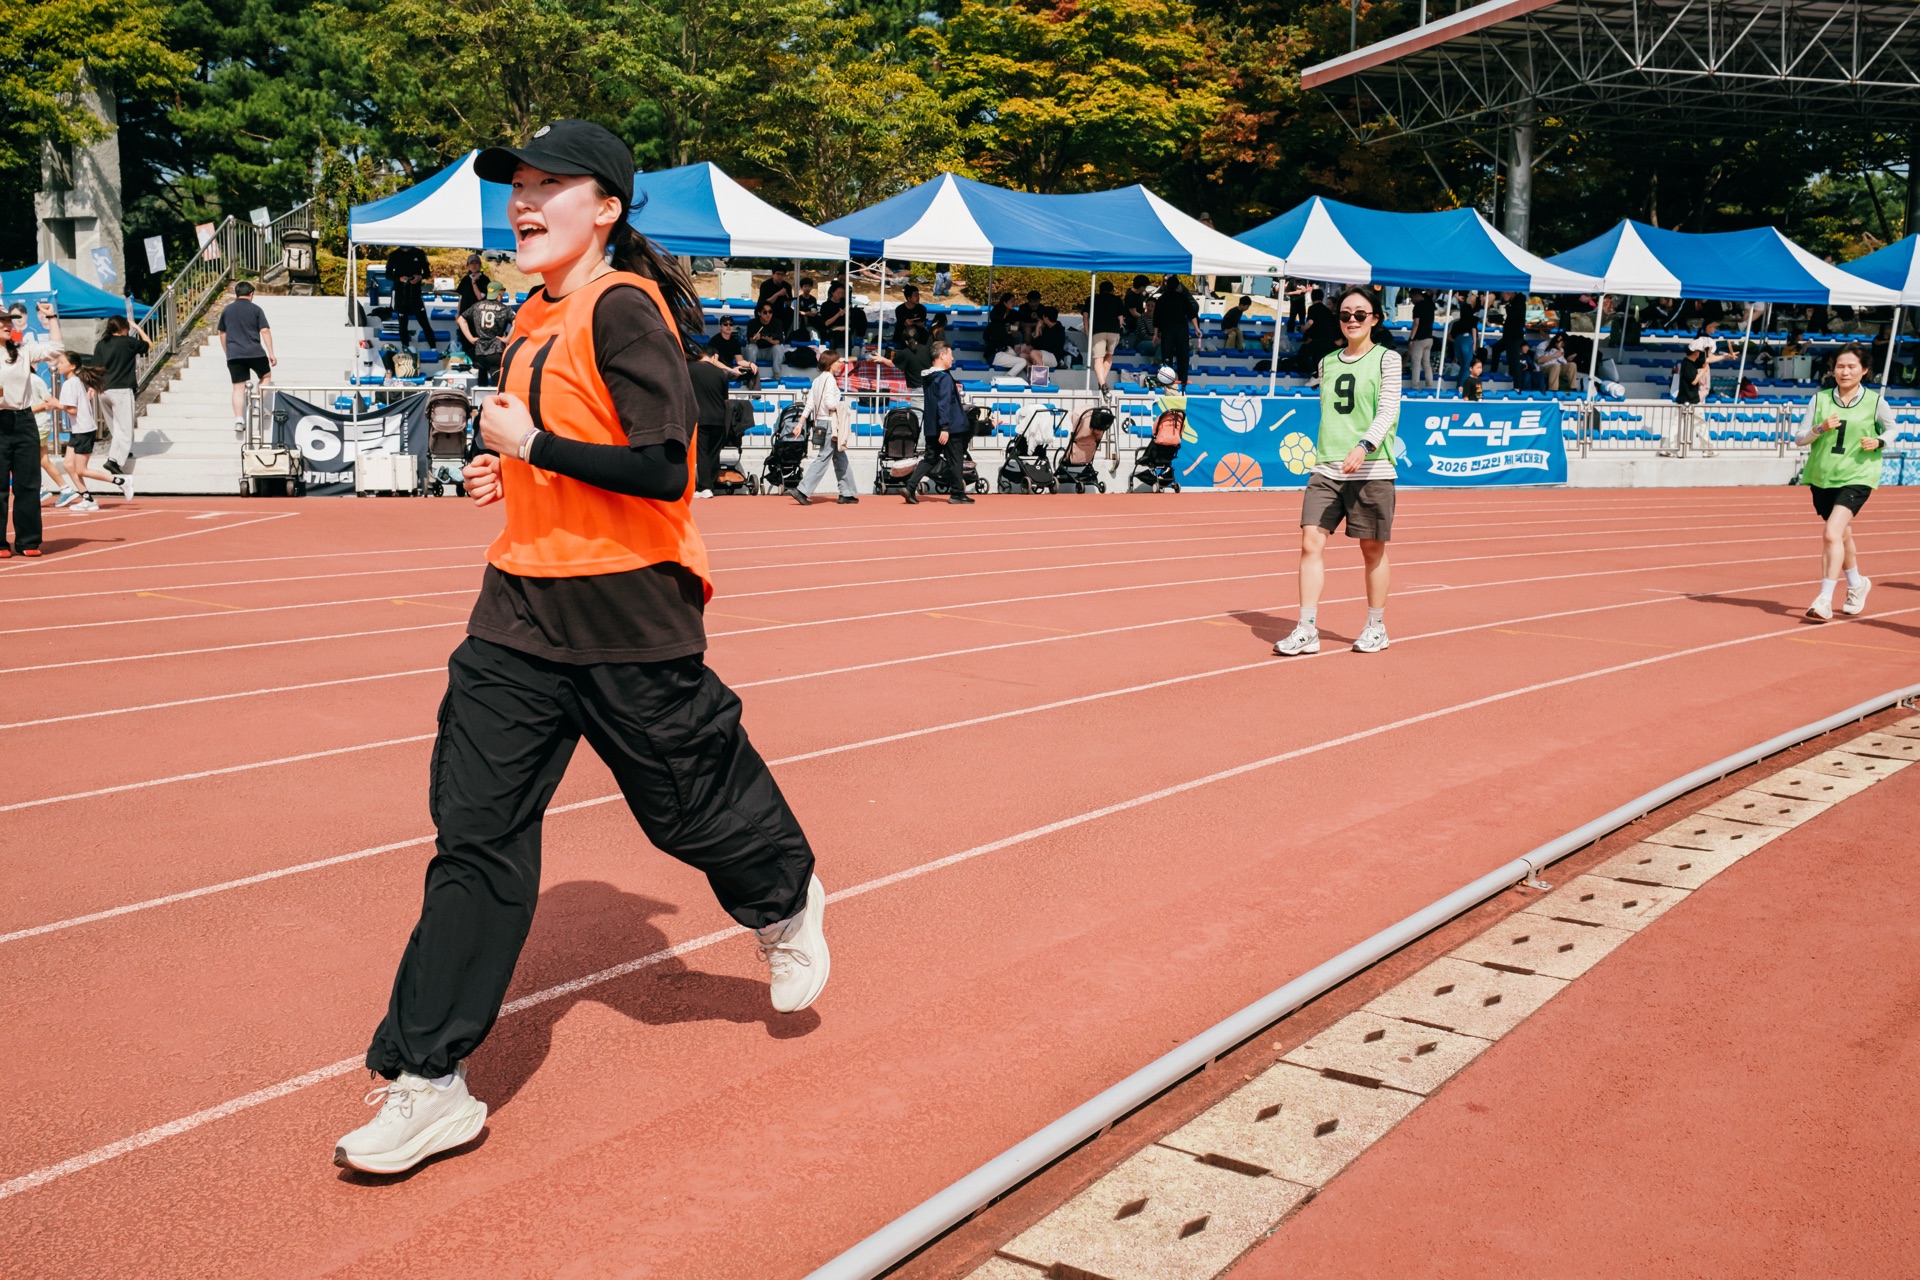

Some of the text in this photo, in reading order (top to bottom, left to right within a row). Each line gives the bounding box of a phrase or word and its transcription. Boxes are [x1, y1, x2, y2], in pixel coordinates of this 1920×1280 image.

[480, 310, 495, 328] 19
[1334, 373, 1356, 414] 9
[1831, 420, 1847, 454] 1
[1436, 452, 1544, 473] 2026 전교인 체육대회
